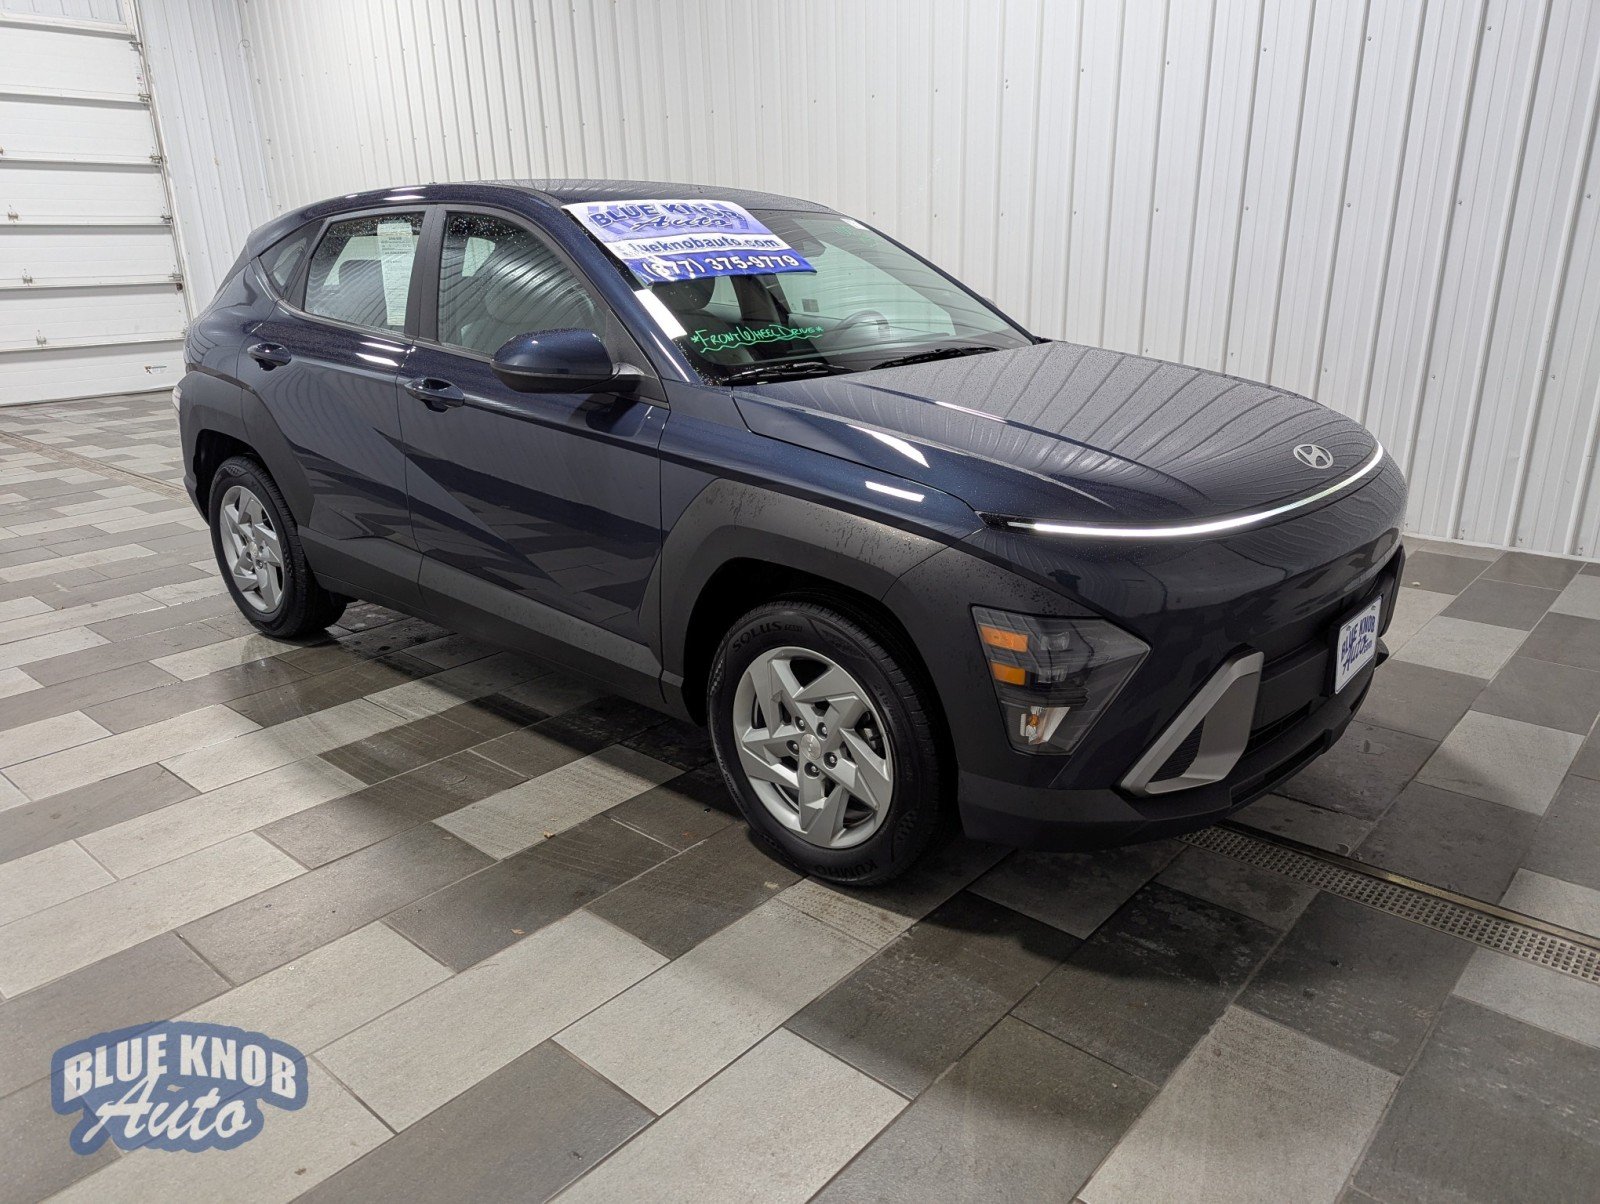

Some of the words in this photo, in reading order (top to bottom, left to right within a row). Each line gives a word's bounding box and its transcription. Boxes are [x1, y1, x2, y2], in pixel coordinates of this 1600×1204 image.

[589, 204, 659, 227] BLUE
[630, 215, 733, 231] Auto
[620, 236, 779, 255] lueknobauto.com
[642, 257, 705, 281] (877)
[704, 255, 800, 272] 375-9779
[732, 620, 782, 652] SOLUS
[815, 859, 879, 877] KUMHO
